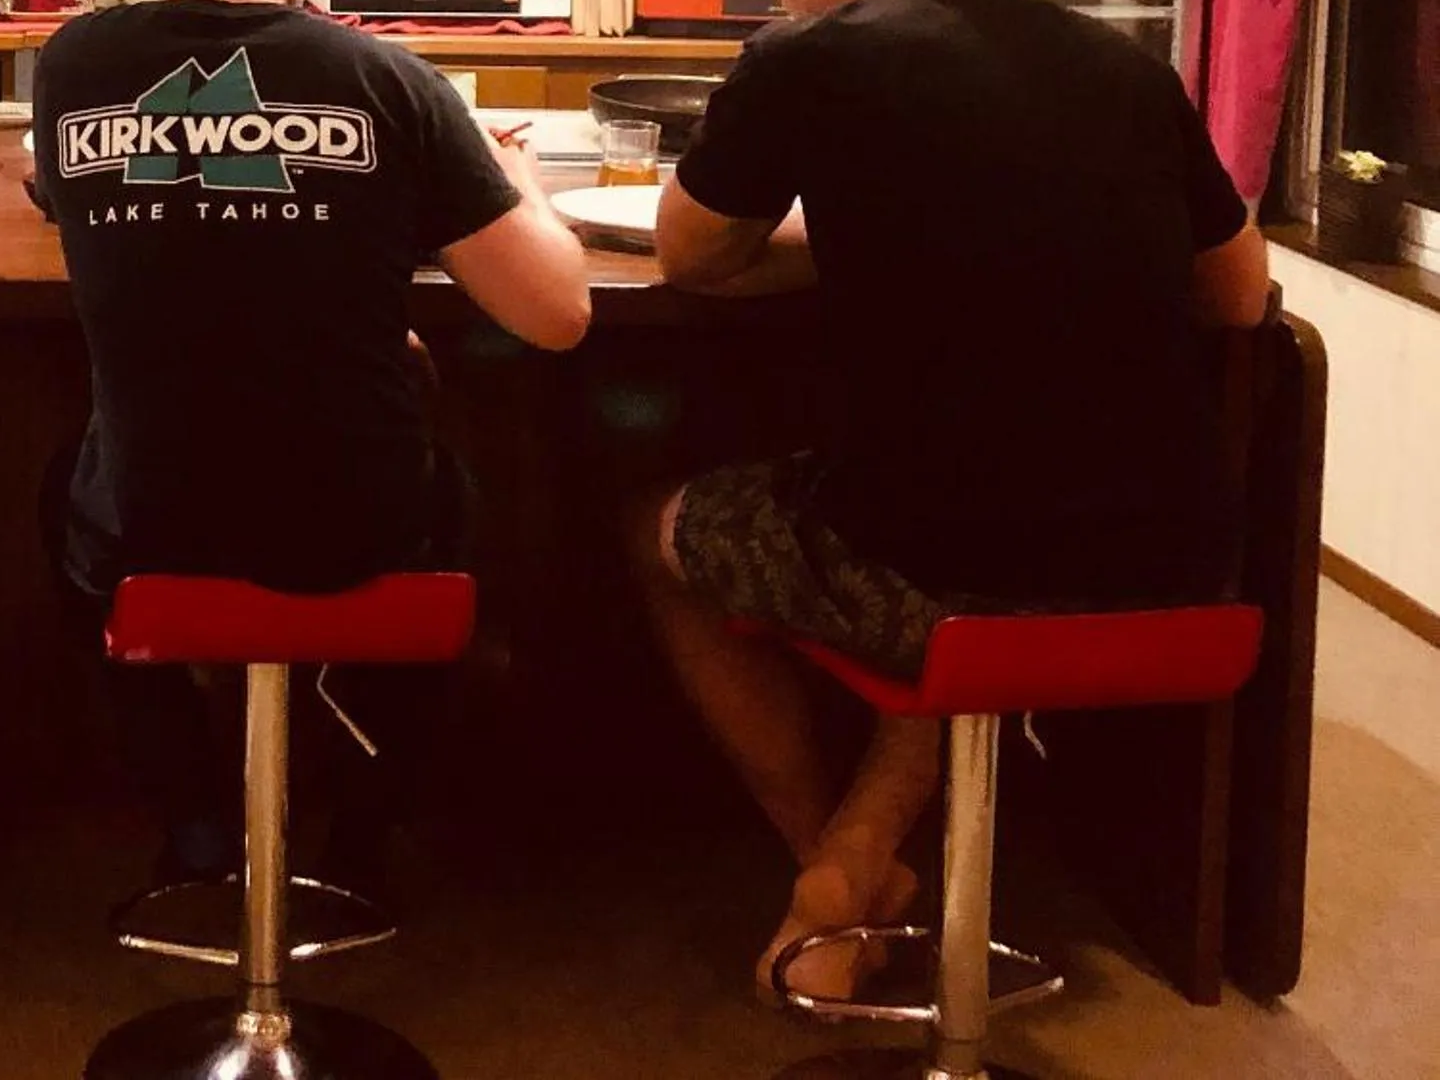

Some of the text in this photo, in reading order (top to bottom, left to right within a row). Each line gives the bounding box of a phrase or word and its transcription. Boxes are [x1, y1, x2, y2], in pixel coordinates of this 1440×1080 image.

[68, 114, 359, 164] KIRKWOOD
[89, 203, 330, 226] LAKE TAHOE
